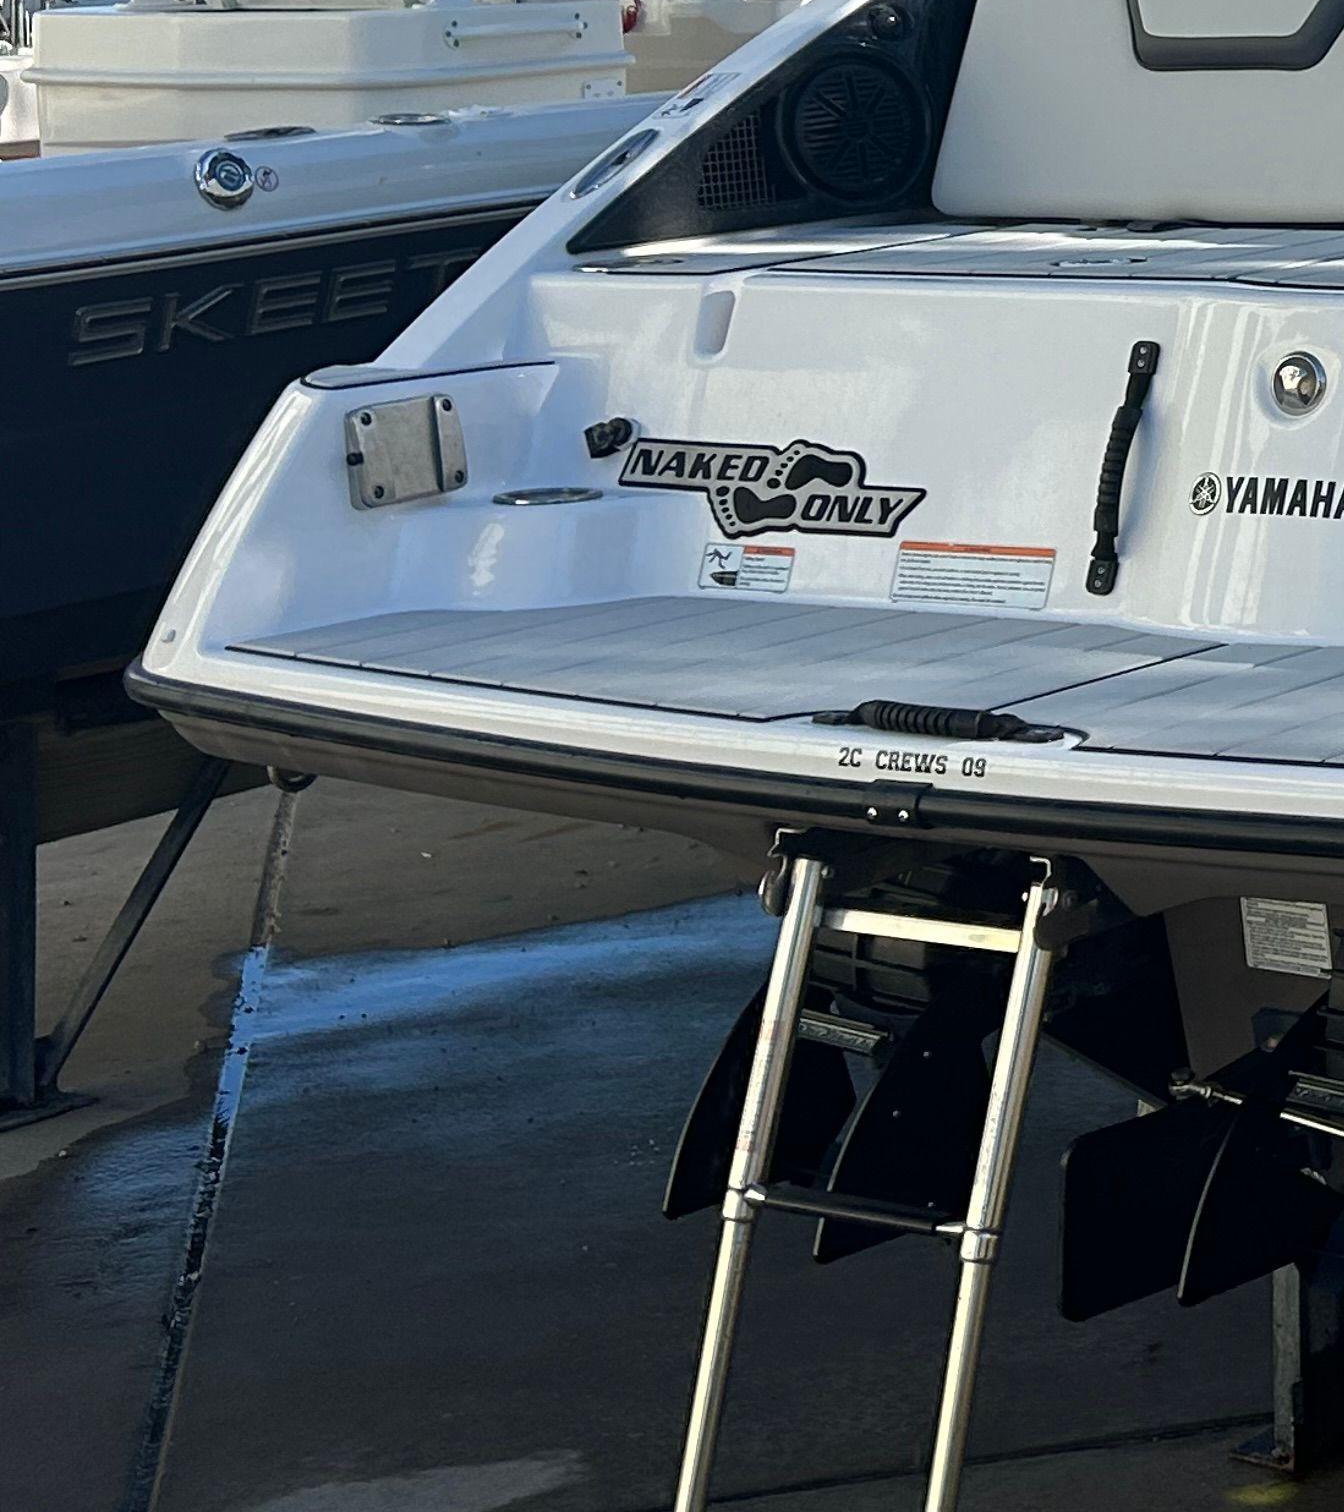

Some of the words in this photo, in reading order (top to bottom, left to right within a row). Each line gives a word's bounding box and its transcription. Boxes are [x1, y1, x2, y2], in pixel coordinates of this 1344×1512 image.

[630, 449, 770, 482] NAKED
[801, 494, 904, 524] ONLY
[838, 747, 863, 767] 2C
[875, 750, 948, 774] CREWS
[962, 757, 986, 777] 09
